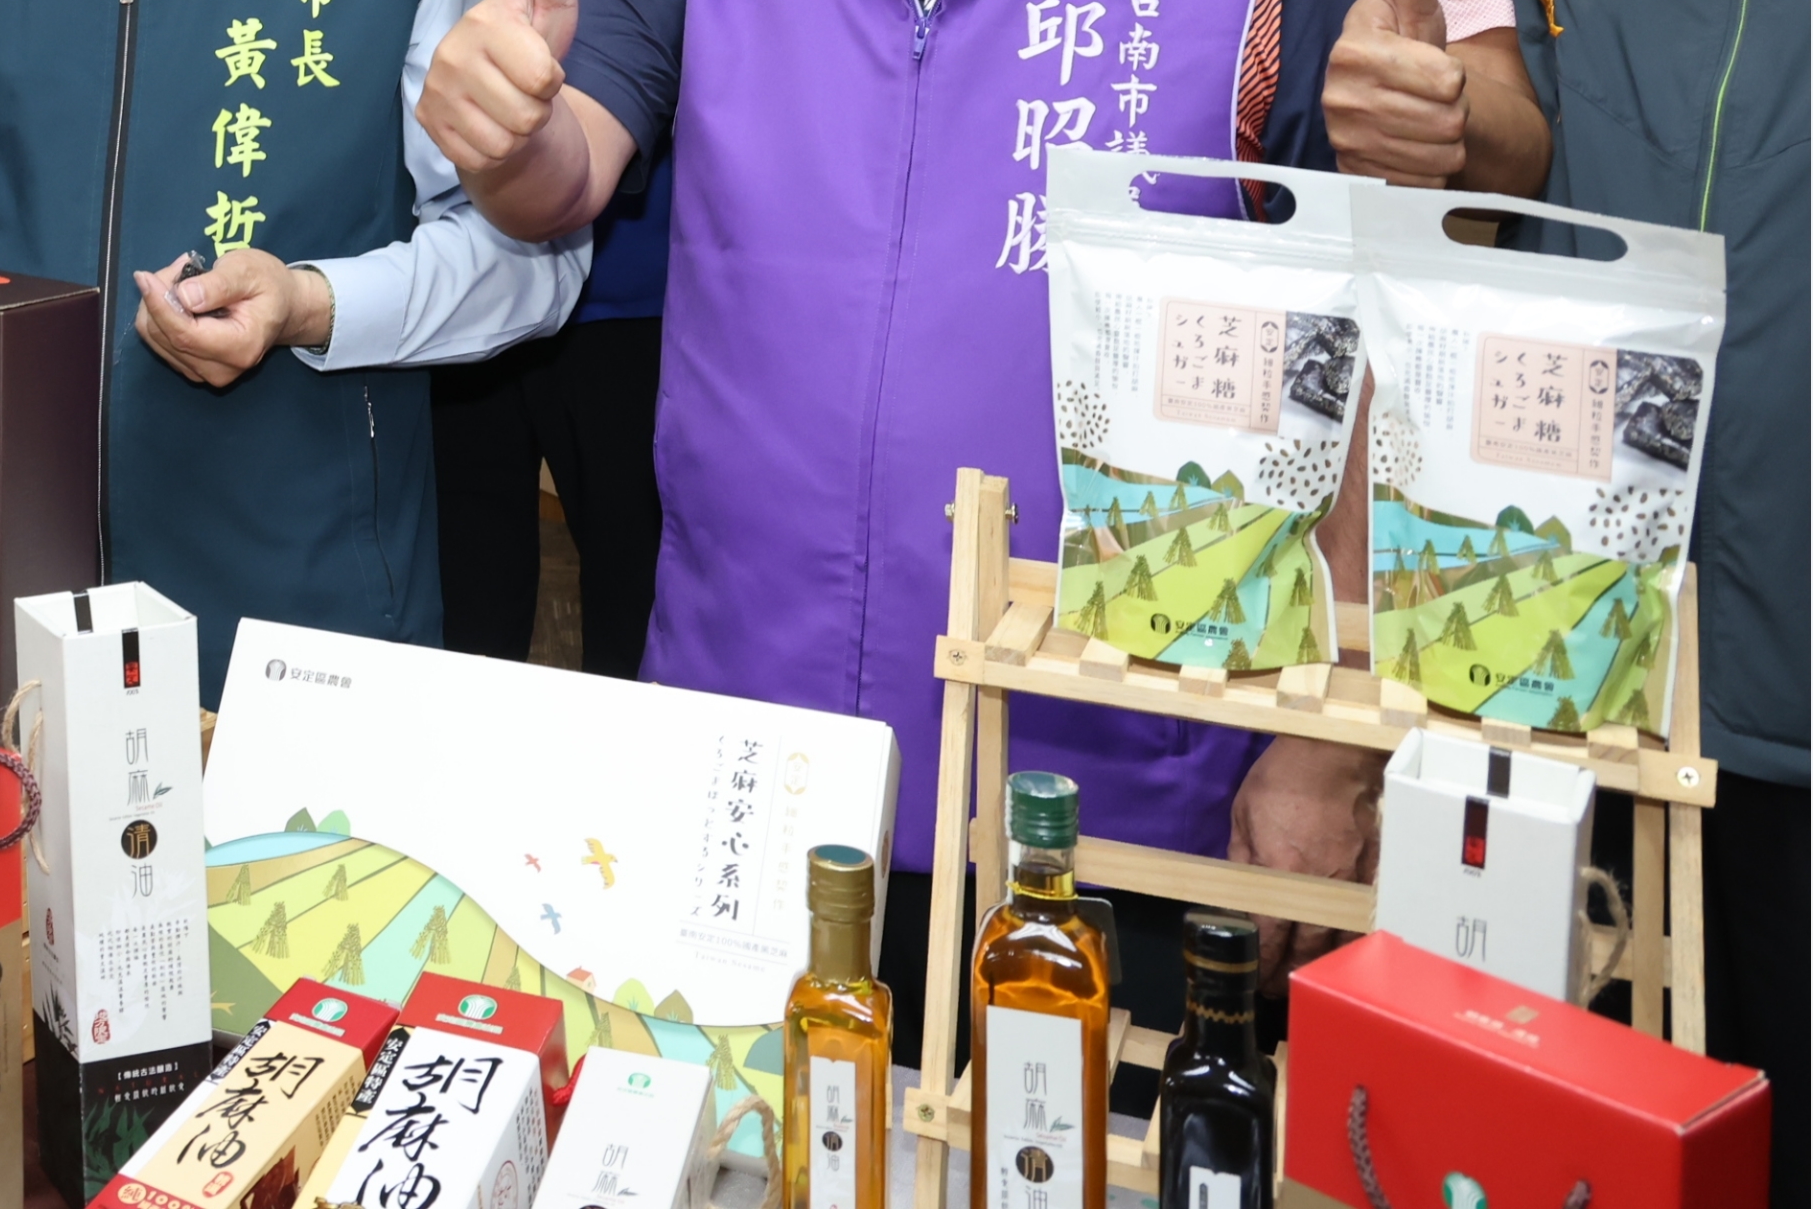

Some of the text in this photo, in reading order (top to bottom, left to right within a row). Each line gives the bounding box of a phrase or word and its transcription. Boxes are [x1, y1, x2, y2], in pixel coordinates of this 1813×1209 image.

[203, 17, 278, 261] 黃偉哲
[1192, 315, 1208, 391] くろごま
[1211, 314, 1242, 399] 芝麻糖
[1512, 351, 1531, 432] くろごま
[1534, 352, 1568, 442] 芝麻糖
[290, 666, 353, 689] 安定區農會
[709, 738, 764, 922] 芝麻安心系列
[1455, 915, 1488, 961] 胡
[176, 1051, 326, 1170] 胡麻油
[354, 1036, 404, 1105] 安定區特產
[357, 1054, 504, 1209] 胡麻油
